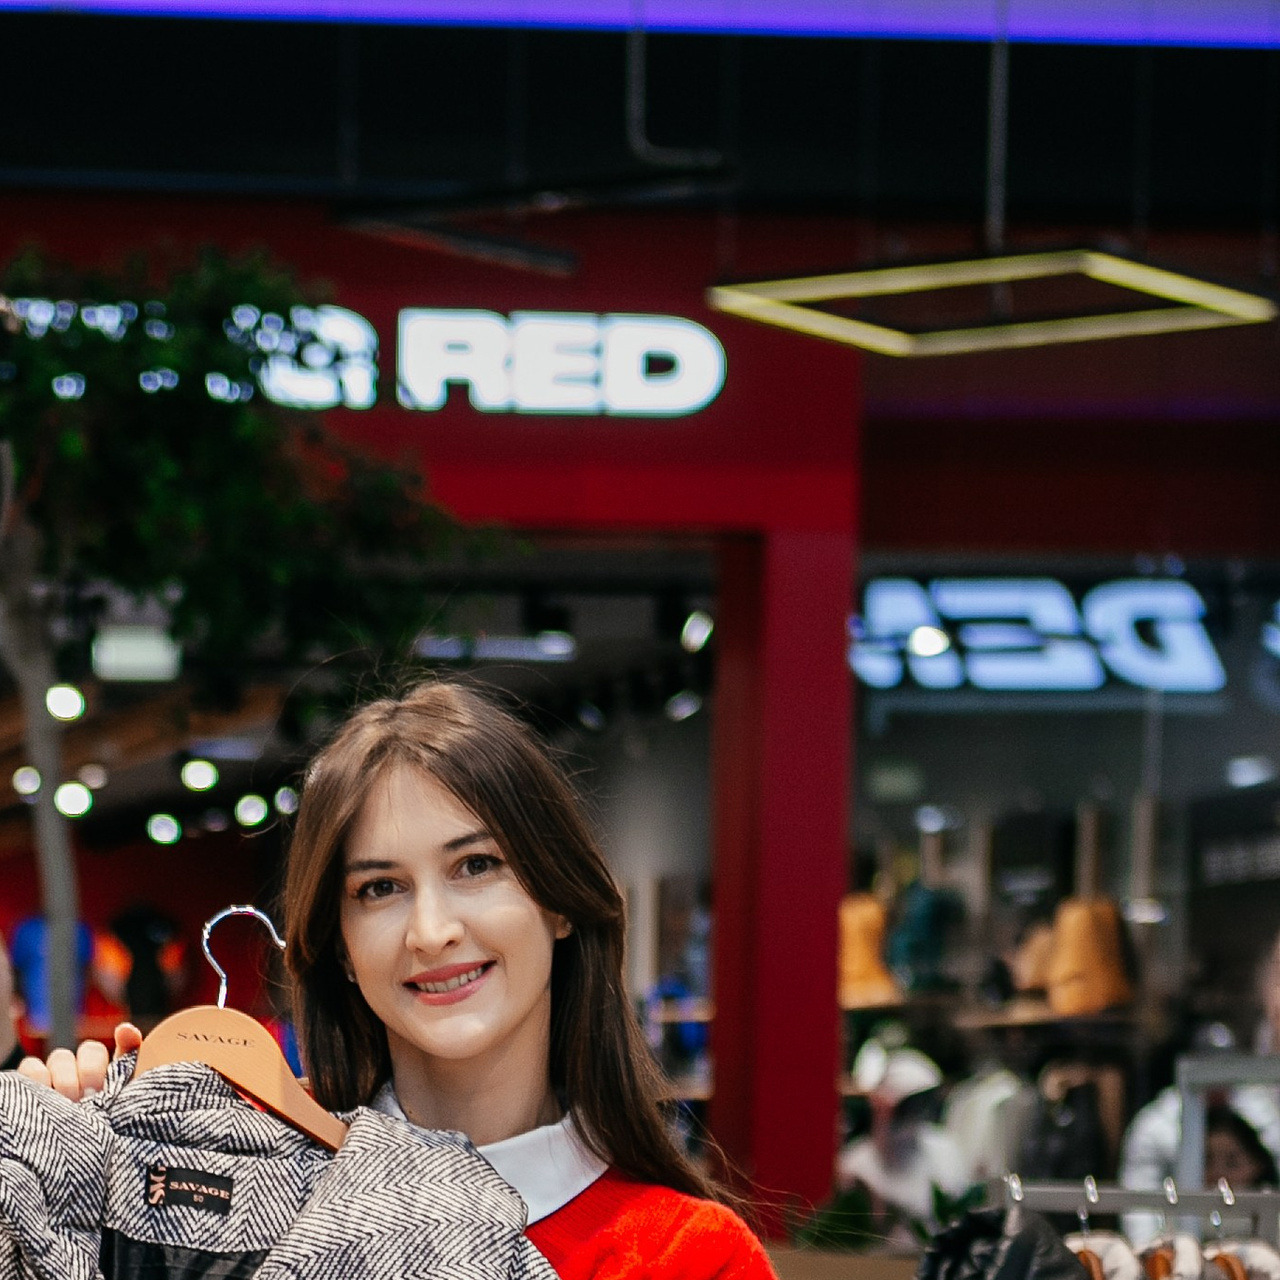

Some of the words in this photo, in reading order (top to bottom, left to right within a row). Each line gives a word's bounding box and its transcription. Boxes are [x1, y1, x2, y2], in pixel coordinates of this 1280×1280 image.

[397, 307, 727, 418] RED
[176, 1032, 255, 1048] SAVAGE
[168, 1181, 230, 1200] SAVAGE
